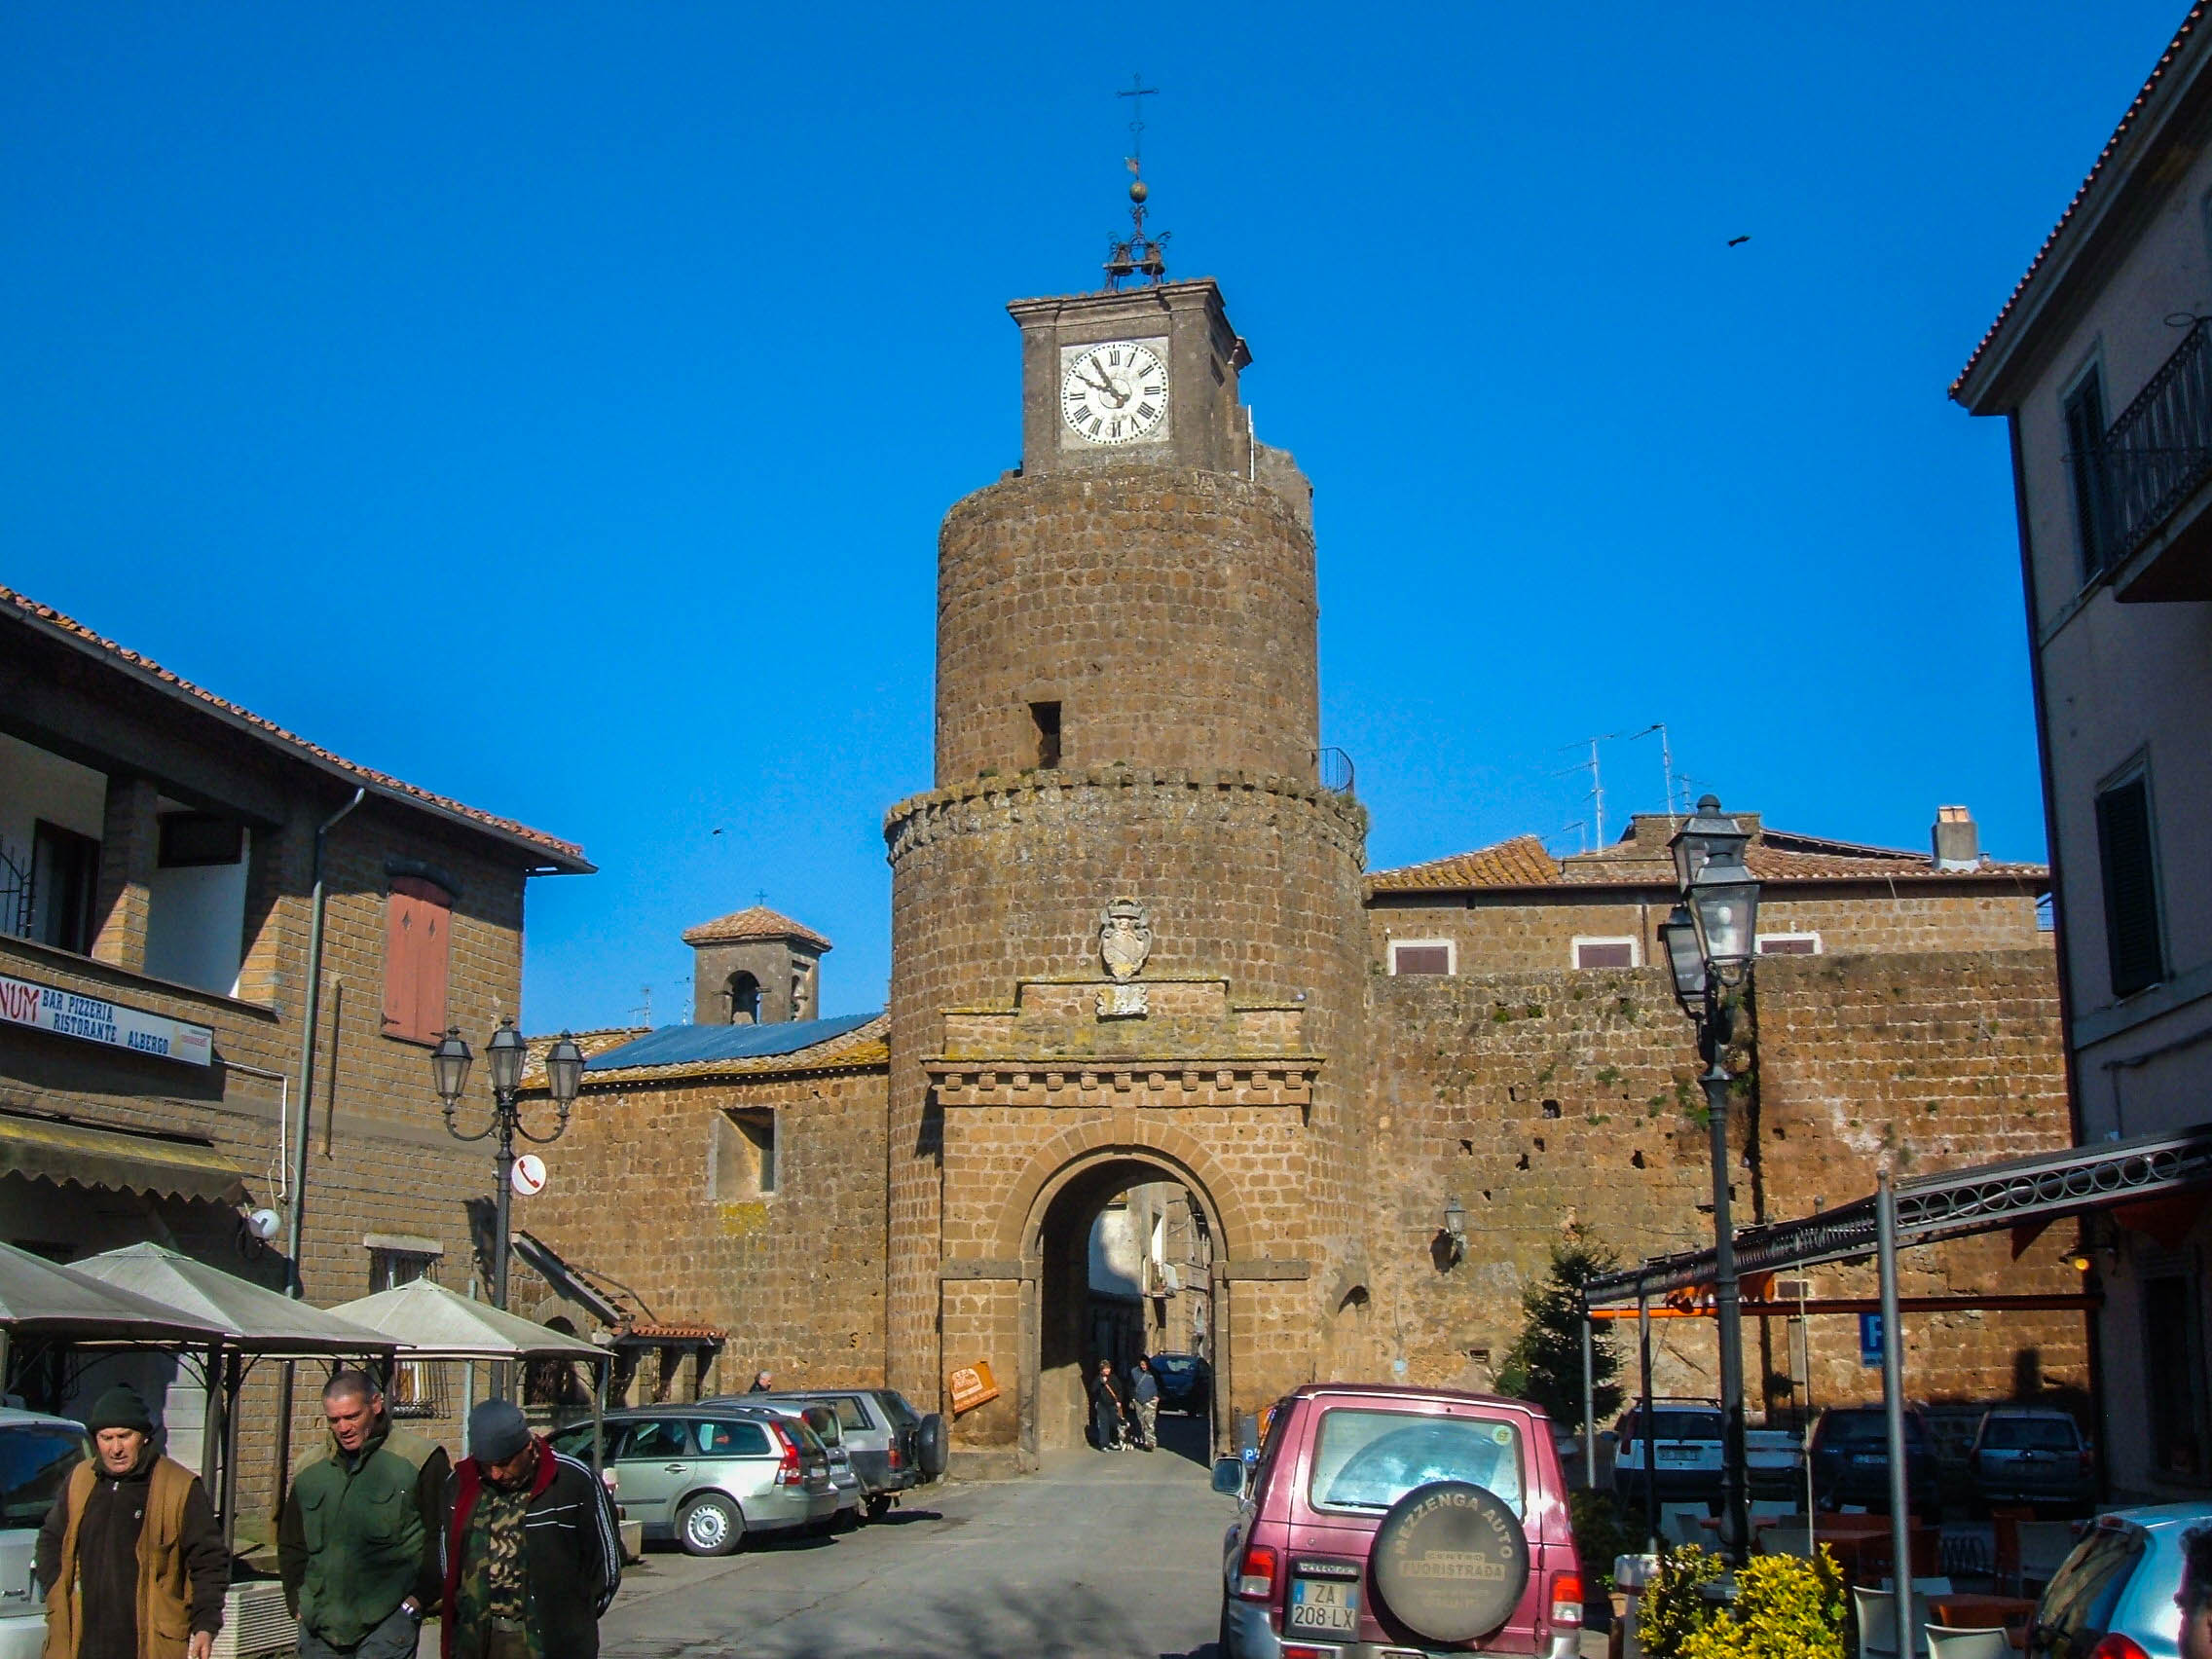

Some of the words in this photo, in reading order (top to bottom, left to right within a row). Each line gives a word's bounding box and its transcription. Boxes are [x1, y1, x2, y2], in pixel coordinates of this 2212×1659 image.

[42, 989, 63, 1011] BAR
[68, 996, 114, 1023] PIZZERIA
[53, 1013, 118, 1043] RISTORANTE
[128, 1030, 169, 1054] ALBERGO
[1480, 1509, 1514, 1559] AUTO
[1314, 1584, 1335, 1604] ZA
